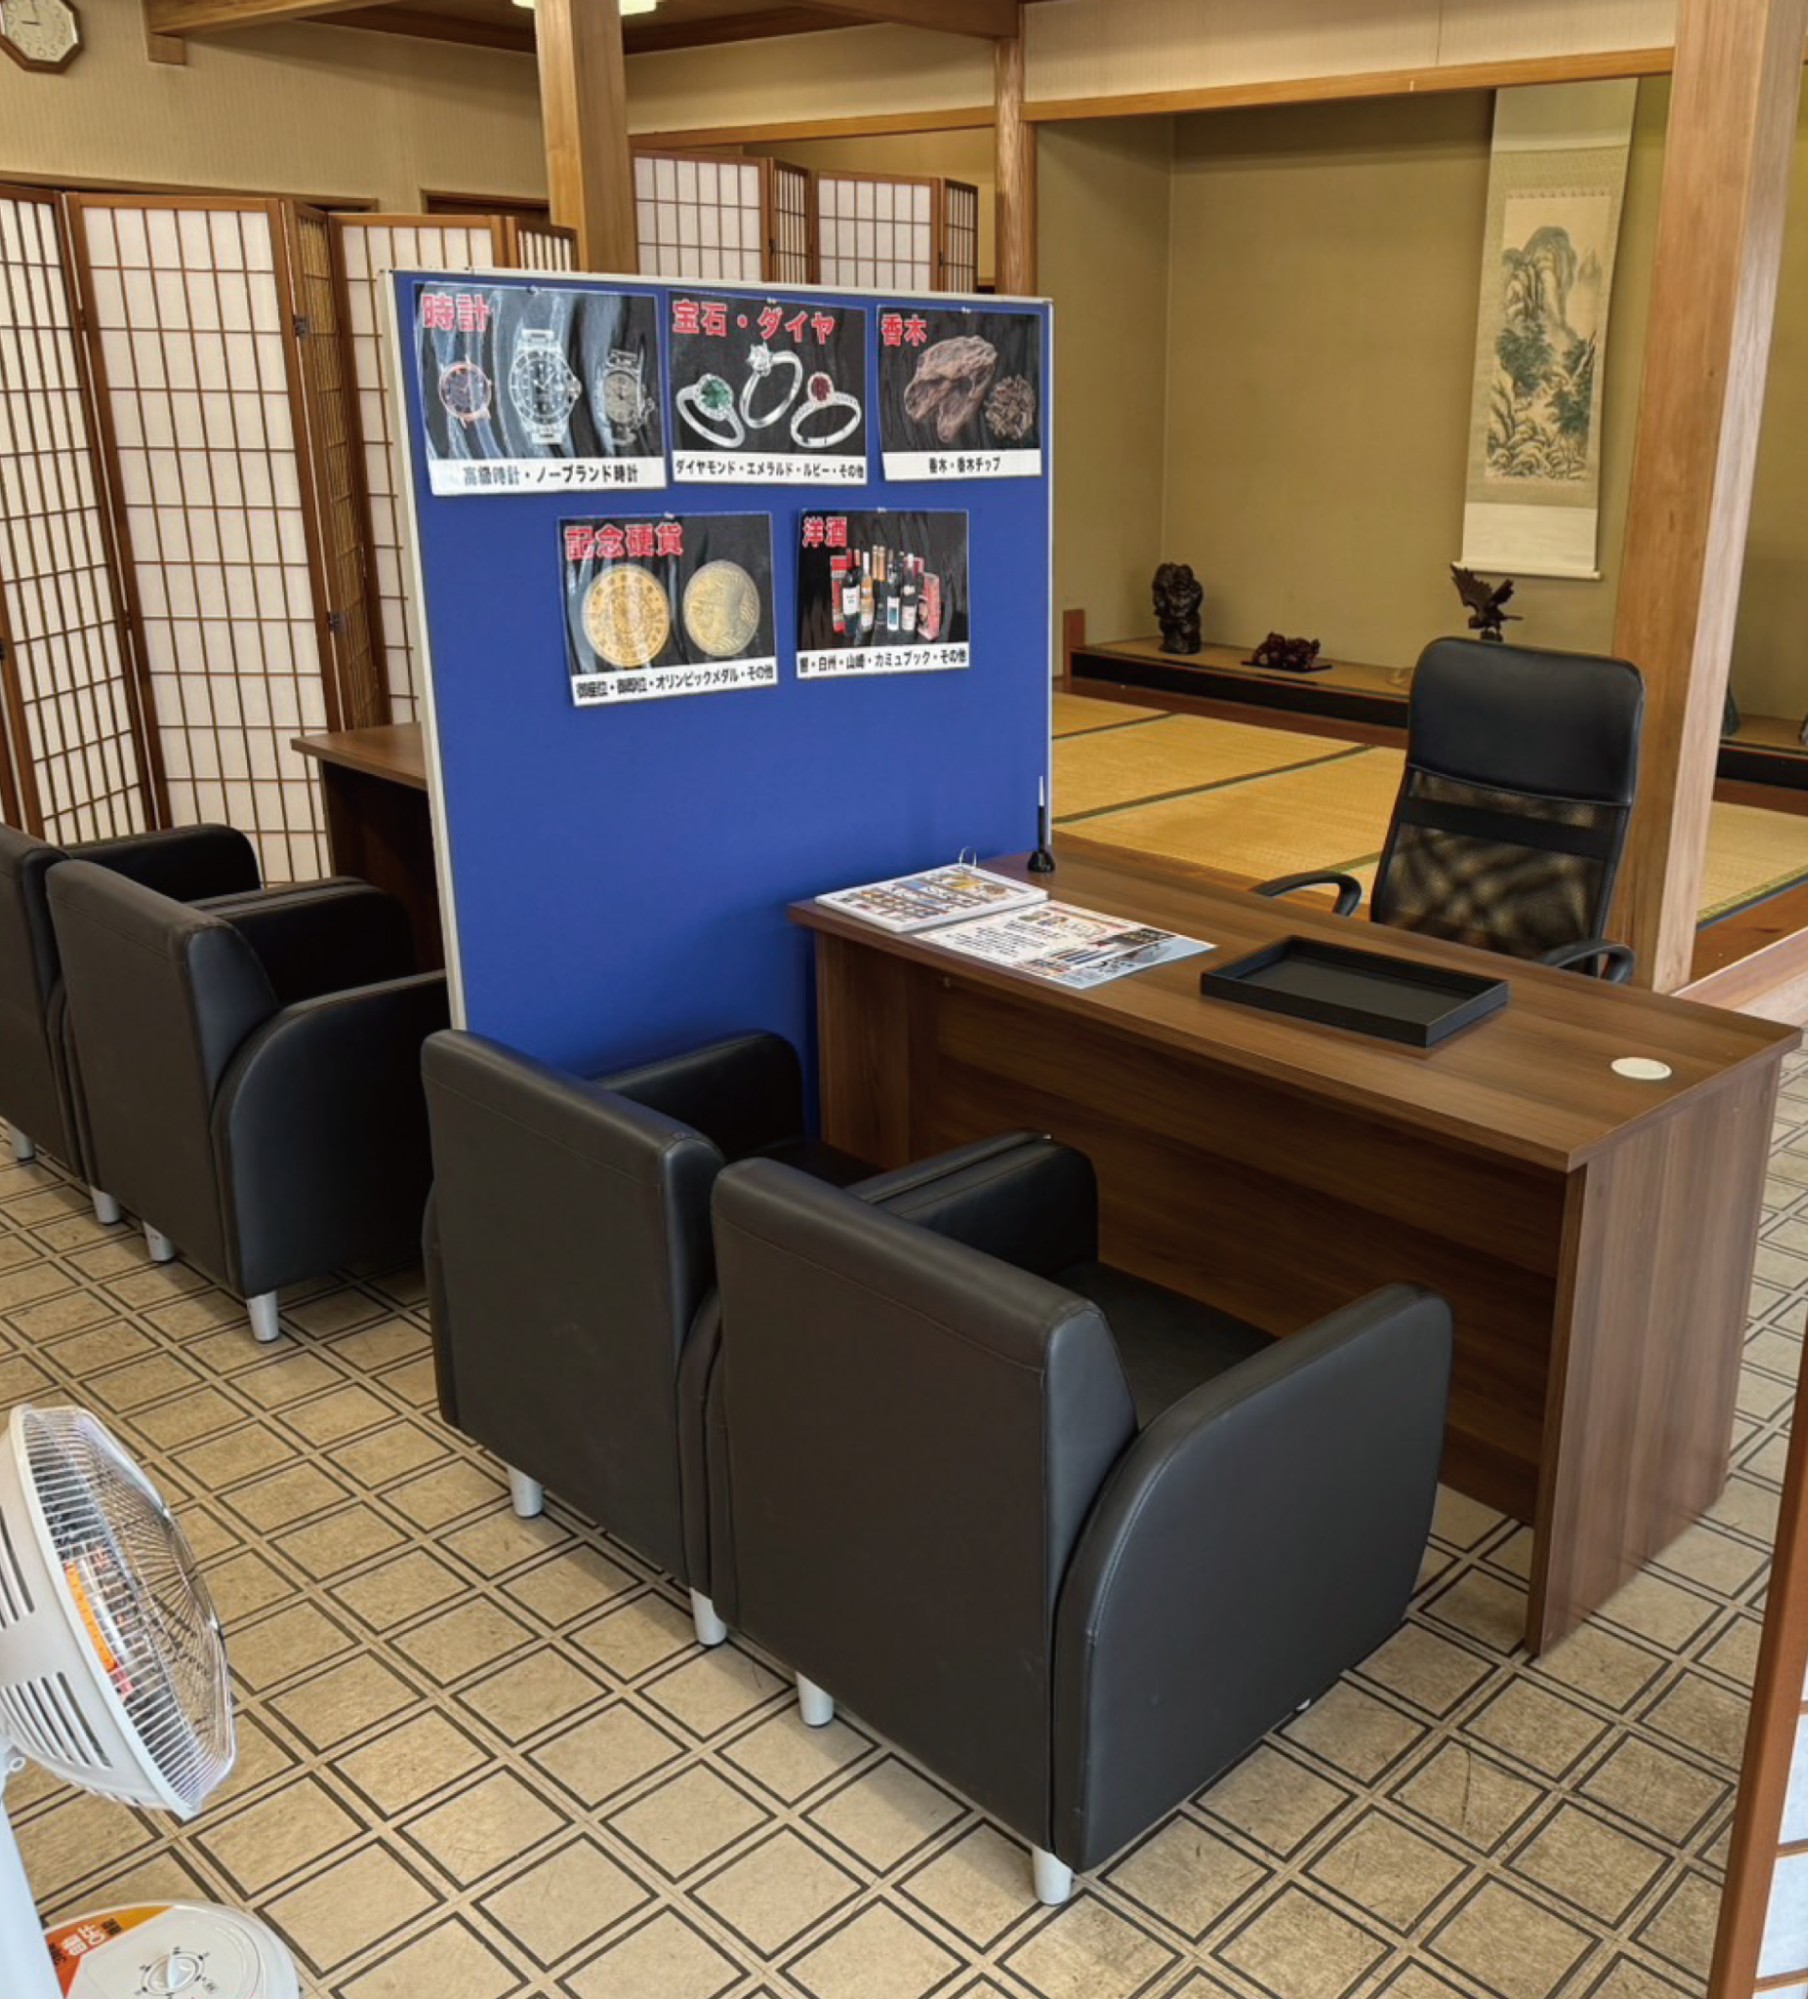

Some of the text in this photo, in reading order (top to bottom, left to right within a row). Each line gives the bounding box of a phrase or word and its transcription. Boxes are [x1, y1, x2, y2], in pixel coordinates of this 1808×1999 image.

[422, 293, 491, 331] 時計
[672, 299, 835, 344] 宝石・ダイヤ
[880, 314, 928, 346] 香木
[675, 459, 864, 480] ダイヤモンド・エメラルド・ルビー・その他
[929, 456, 1001, 474] 香木・香木チップ
[564, 522, 684, 560] 記念硬貨
[802, 516, 848, 548] 洋酒
